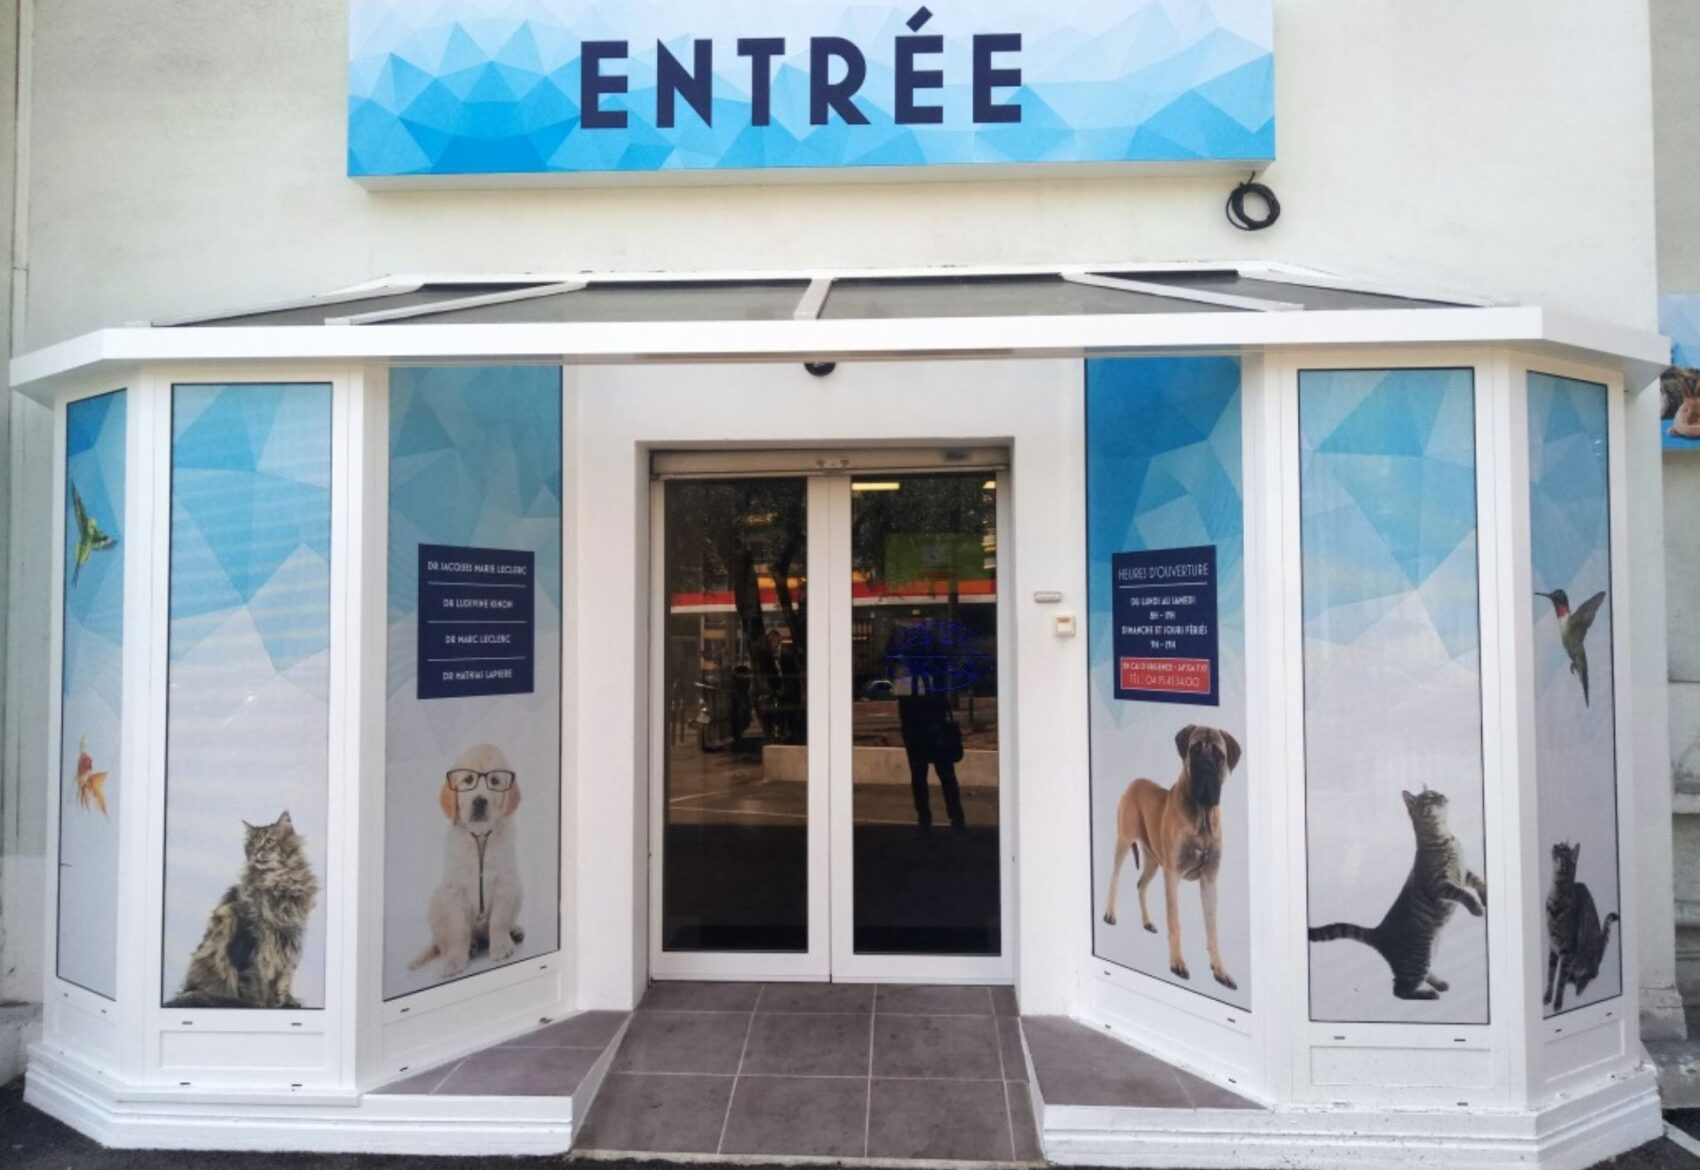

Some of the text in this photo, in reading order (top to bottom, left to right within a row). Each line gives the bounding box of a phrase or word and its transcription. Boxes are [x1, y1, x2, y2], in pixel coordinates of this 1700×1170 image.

[580, 5, 1023, 129] ENTRÉE
[427, 561, 527, 575] DR JACQUES MARIE LECLERC
[1118, 562, 1209, 581] HEURES D'OUVERTURE
[443, 598, 454, 608] DR
[1130, 595, 1196, 606] DU LUNDI AU SAMEDI
[1121, 625, 1153, 635] DIMANCHE
[1154, 625, 1163, 635] ET
[1164, 625, 1185, 635] JOURS
[445, 634, 511, 644] DR MARC LECLERC
[442, 672, 454, 681] DR
